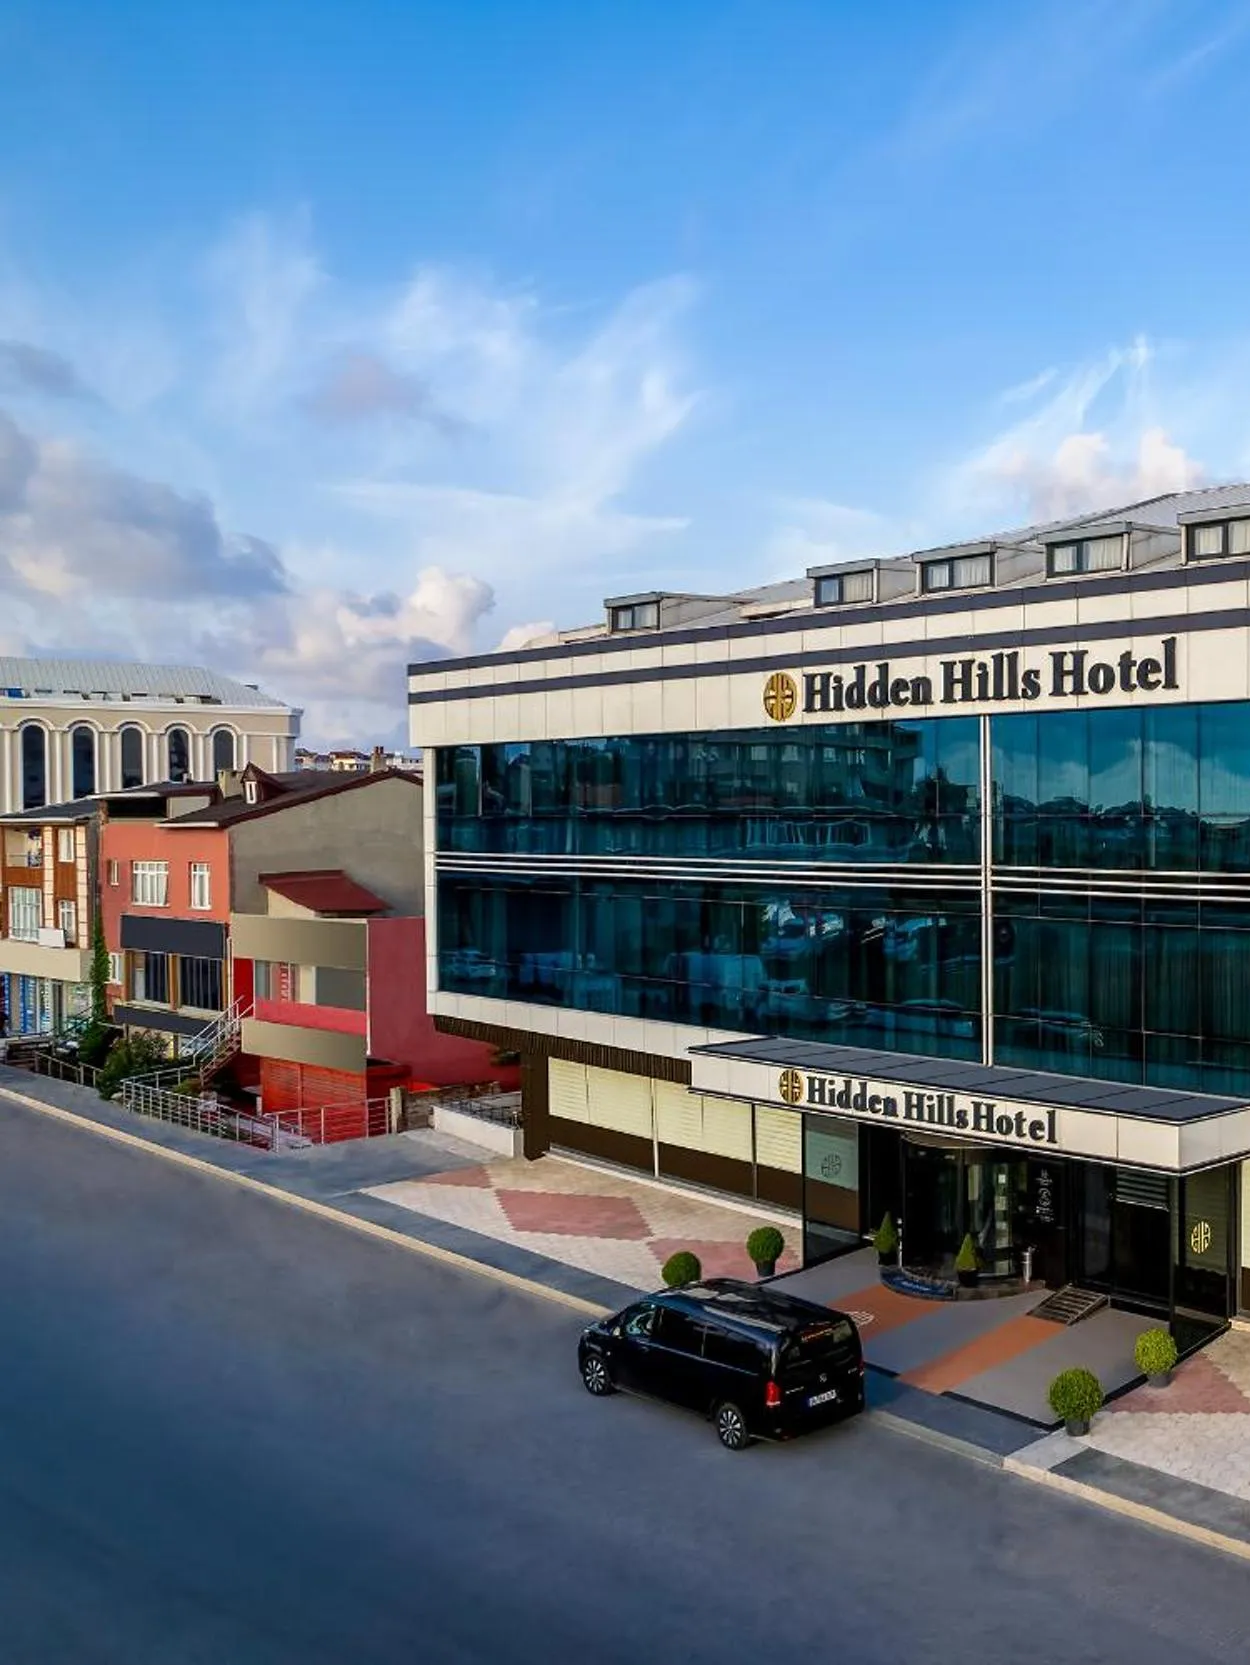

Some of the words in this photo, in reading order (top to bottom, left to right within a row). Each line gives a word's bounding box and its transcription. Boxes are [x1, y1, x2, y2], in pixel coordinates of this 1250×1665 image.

[802, 662, 934, 713] Hidden
[940, 651, 1041, 704] Hills
[1048, 636, 1180, 697] Hotel
[806, 1076, 899, 1118] Hidden
[902, 1090, 969, 1130] Hills
[971, 1101, 1058, 1144] Hotel
